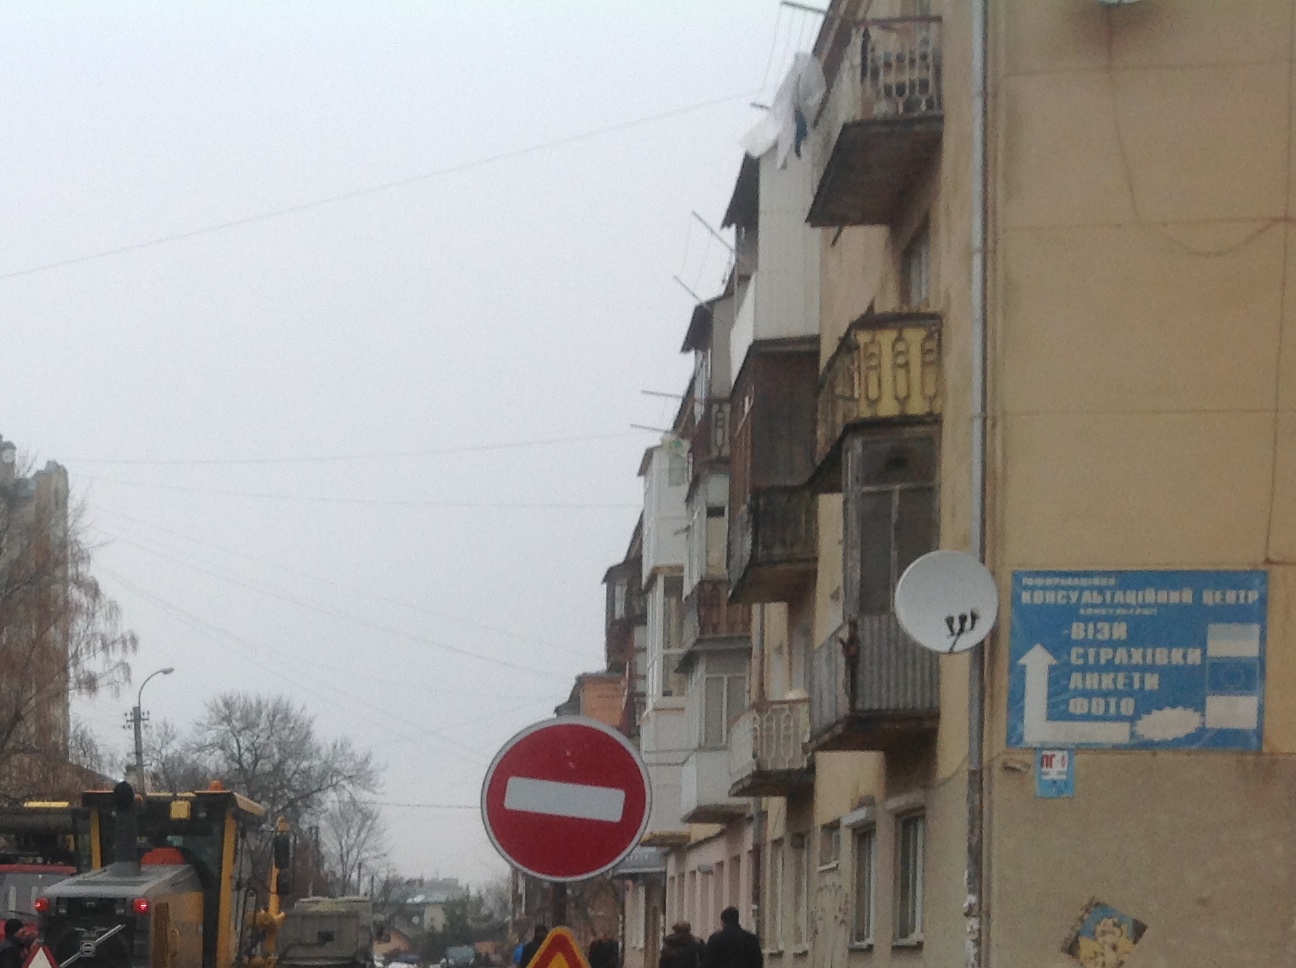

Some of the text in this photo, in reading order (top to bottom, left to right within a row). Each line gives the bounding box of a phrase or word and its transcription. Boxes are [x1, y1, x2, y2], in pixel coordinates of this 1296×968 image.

[1021, 586, 1260, 606] КОНСУЛЬТАЦІЙНИЙ ЦЕНТР
[1070, 621, 1128, 641] ВІЗИ
[1070, 647, 1202, 666] СТРАХІВКИ
[1069, 672, 1160, 691] АНКЕТИ
[1068, 697, 1136, 716] ФОТО
